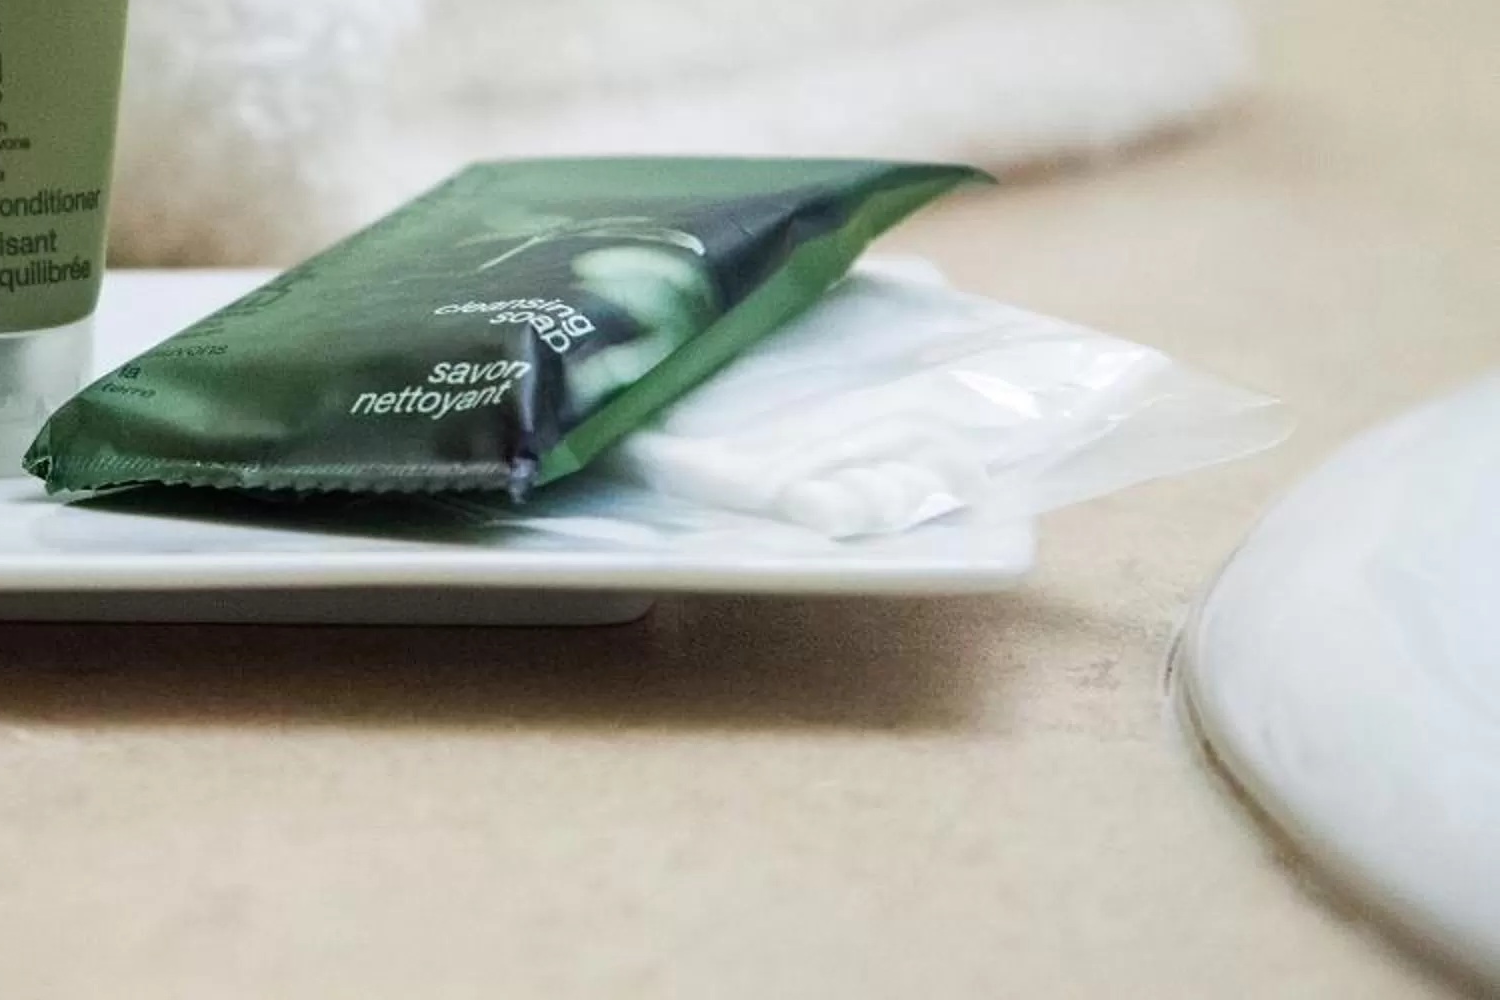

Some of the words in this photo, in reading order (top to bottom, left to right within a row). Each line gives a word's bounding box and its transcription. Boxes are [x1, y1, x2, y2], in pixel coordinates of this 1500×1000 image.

[434, 299, 595, 337] cleansing
[489, 311, 571, 353] soap
[428, 359, 532, 385] savon
[351, 380, 512, 420] nettoyant
